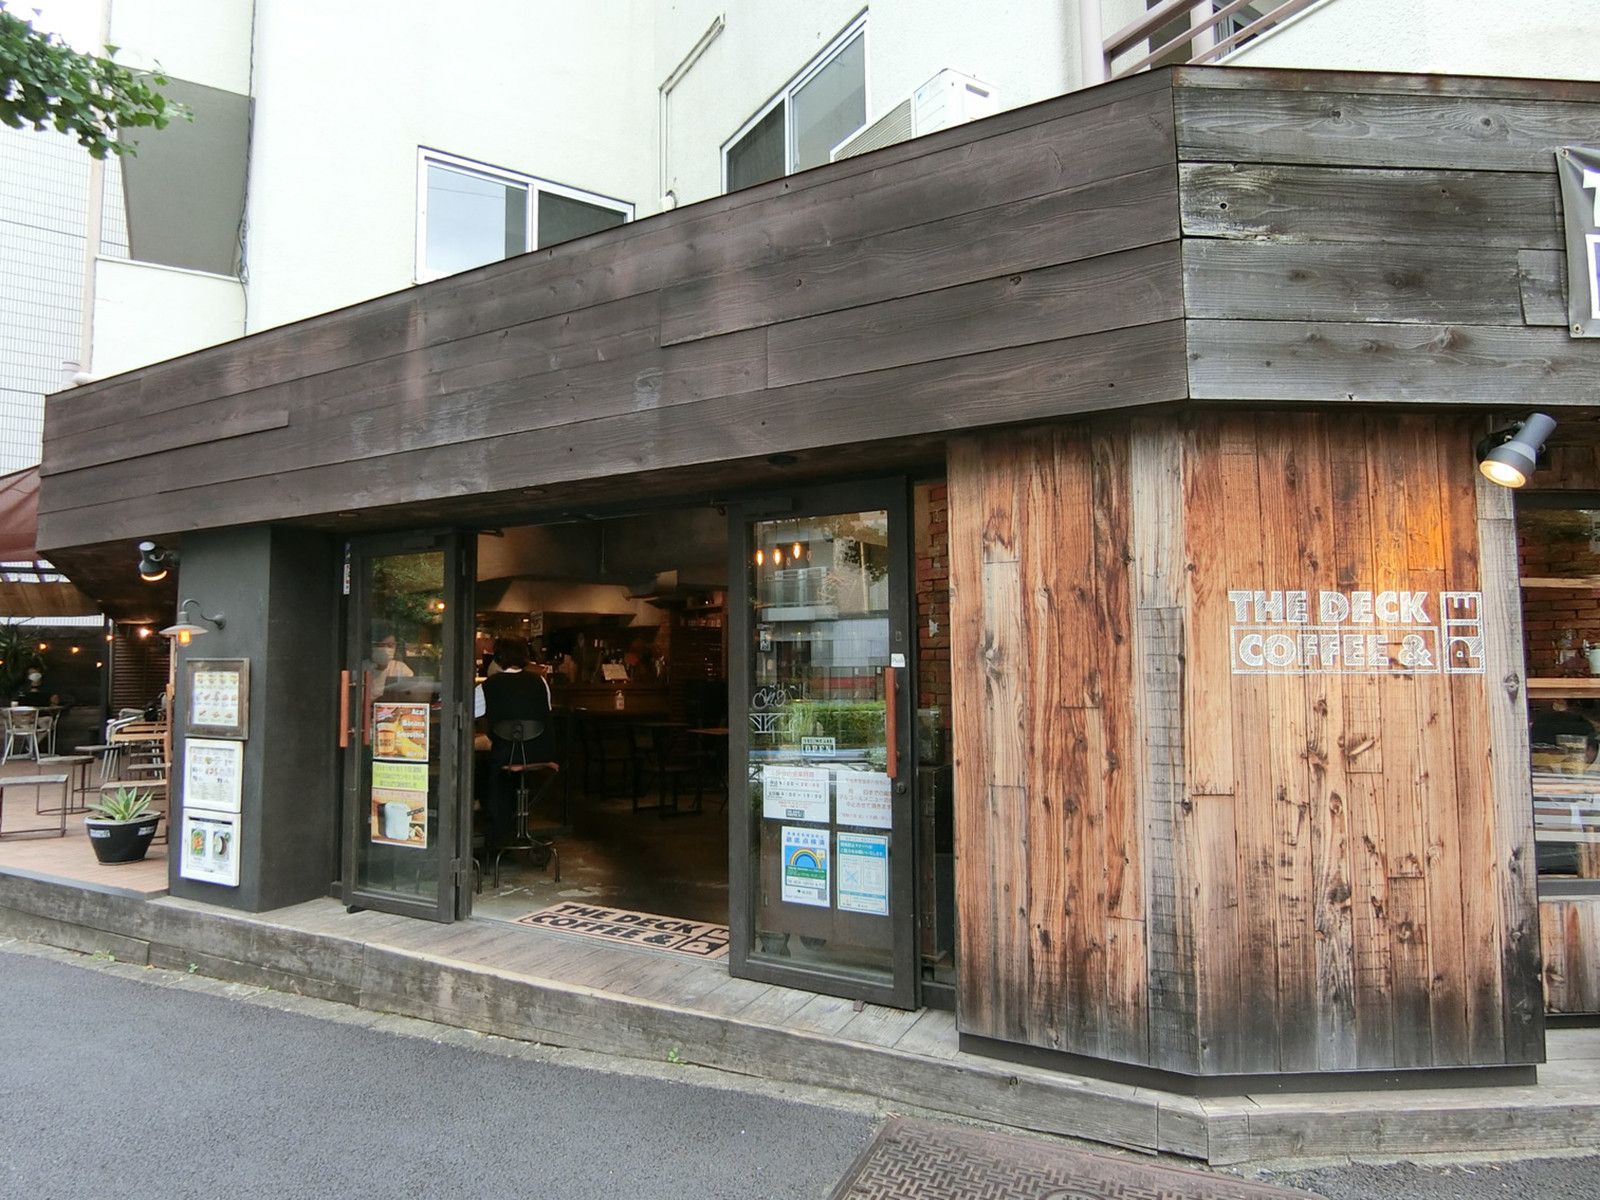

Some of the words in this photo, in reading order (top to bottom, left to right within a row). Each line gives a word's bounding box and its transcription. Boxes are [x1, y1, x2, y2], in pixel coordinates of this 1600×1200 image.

[1228, 590, 1308, 623] THE
[1319, 590, 1431, 624] DECK
[1441, 591, 1485, 673] PIE
[1239, 634, 1389, 667] COFFEE
[1398, 634, 1434, 667] &
[805, 744, 833, 753] OPEN
[531, 914, 640, 940] COFFEE
[642, 933, 675, 947] &
[557, 904, 616, 920] THE
[615, 914, 703, 934] DECK
